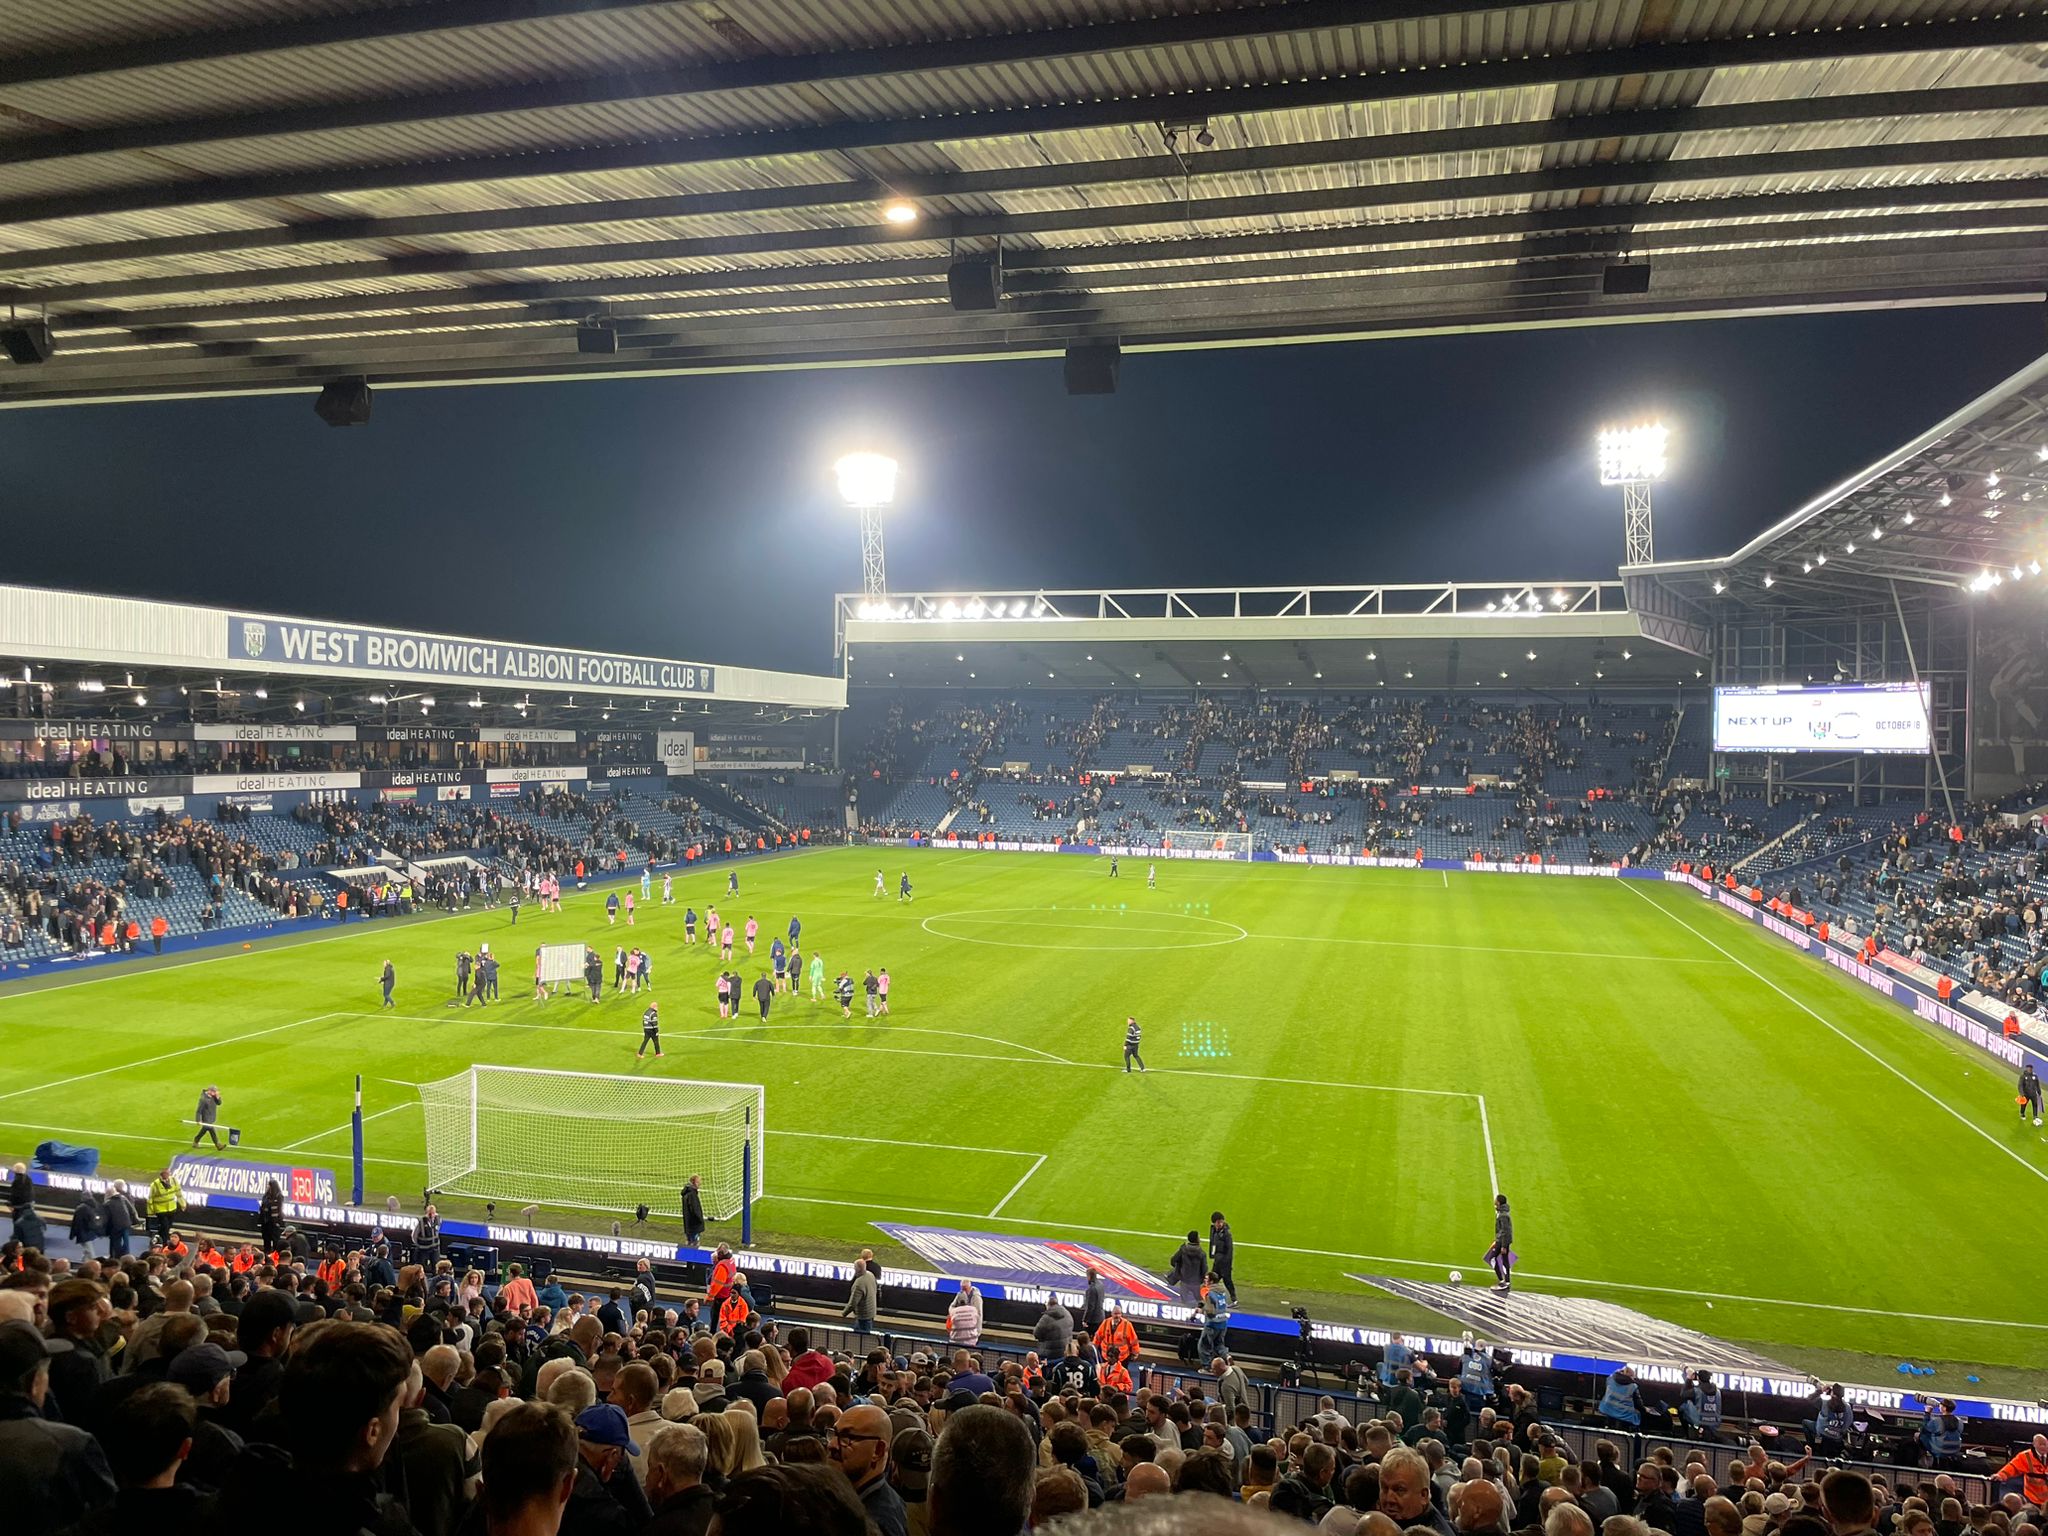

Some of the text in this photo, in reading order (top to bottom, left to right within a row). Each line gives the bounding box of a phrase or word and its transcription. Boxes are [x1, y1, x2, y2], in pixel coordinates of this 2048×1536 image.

[280, 626, 695, 689] WEST BROMWICH ALBION FOOTBALL CLUB
[1728, 717, 1792, 726] NEXT UP
[1876, 721, 1911, 730] OCTOBER
[34, 722, 152, 738] ideal HEATING
[236, 726, 324, 739] ideal HEATING
[387, 728, 455, 740] ideal HEATING
[504, 730, 558, 741] ideal HEATING
[597, 731, 642, 741] ideal HEATING
[664, 739, 688, 756] ideal
[392, 772, 461, 786] ideal HEATING
[511, 769, 567, 781] ideal HEATING
[606, 767, 651, 777] ideal HEATING
[27, 781, 148, 799] ideal HEATING
[236, 776, 326, 790] ideal HEATING
[932, 839, 959, 849] THANK
[961, 840, 979, 849] YOU
[998, 842, 1020, 851] YOUR
[1021, 843, 1060, 853] SUPPORT
[1100, 846, 1235, 859] THANK YOU FOR YOUR SUPPORT
[1279, 853, 1308, 863] THANK
[1311, 855, 1329, 864] YOU
[1332, 855, 1349, 865] FOR
[1353, 856, 1377, 866] YOUR
[1464, 861, 1620, 877] THANK YOU FOR YOUR SUPPORT
[1917, 995, 1938, 1021] THANK
[1938, 1005, 1951, 1029] YOU
[1952, 1013, 1966, 1037] FOR
[1968, 1020, 1986, 1048] YOUR
[1987, 1032, 2023, 1068] SUPPORT
[190, 1164, 230, 1190] BETTING
[49, 1174, 83, 1191] THANK
[130, 1184, 150, 1199] YOU
[294, 1173, 333, 1204] sky bet
[298, 1205, 320, 1218] YOU
[323, 1207, 345, 1222] FOR
[348, 1210, 378, 1226] YOUR
[380, 1215, 419, 1230] SUPPO
[488, 1226, 679, 1260] THANK YOU FOR YOUR SUPPORT
[734, 1254, 939, 1291] THANK YOU FOR YO SUPPORT
[1004, 1286, 1051, 1304] THANK
[1055, 1291, 1085, 1309] YOU
[1116, 1299, 1159, 1319] YOUR
[1311, 1324, 1465, 1356] HANK YOU OR YOU
[1067, 1371, 1083, 1388] 18
[1729, 1374, 1764, 1393] FOR
[1842, 1388, 1903, 1408] PPORT
